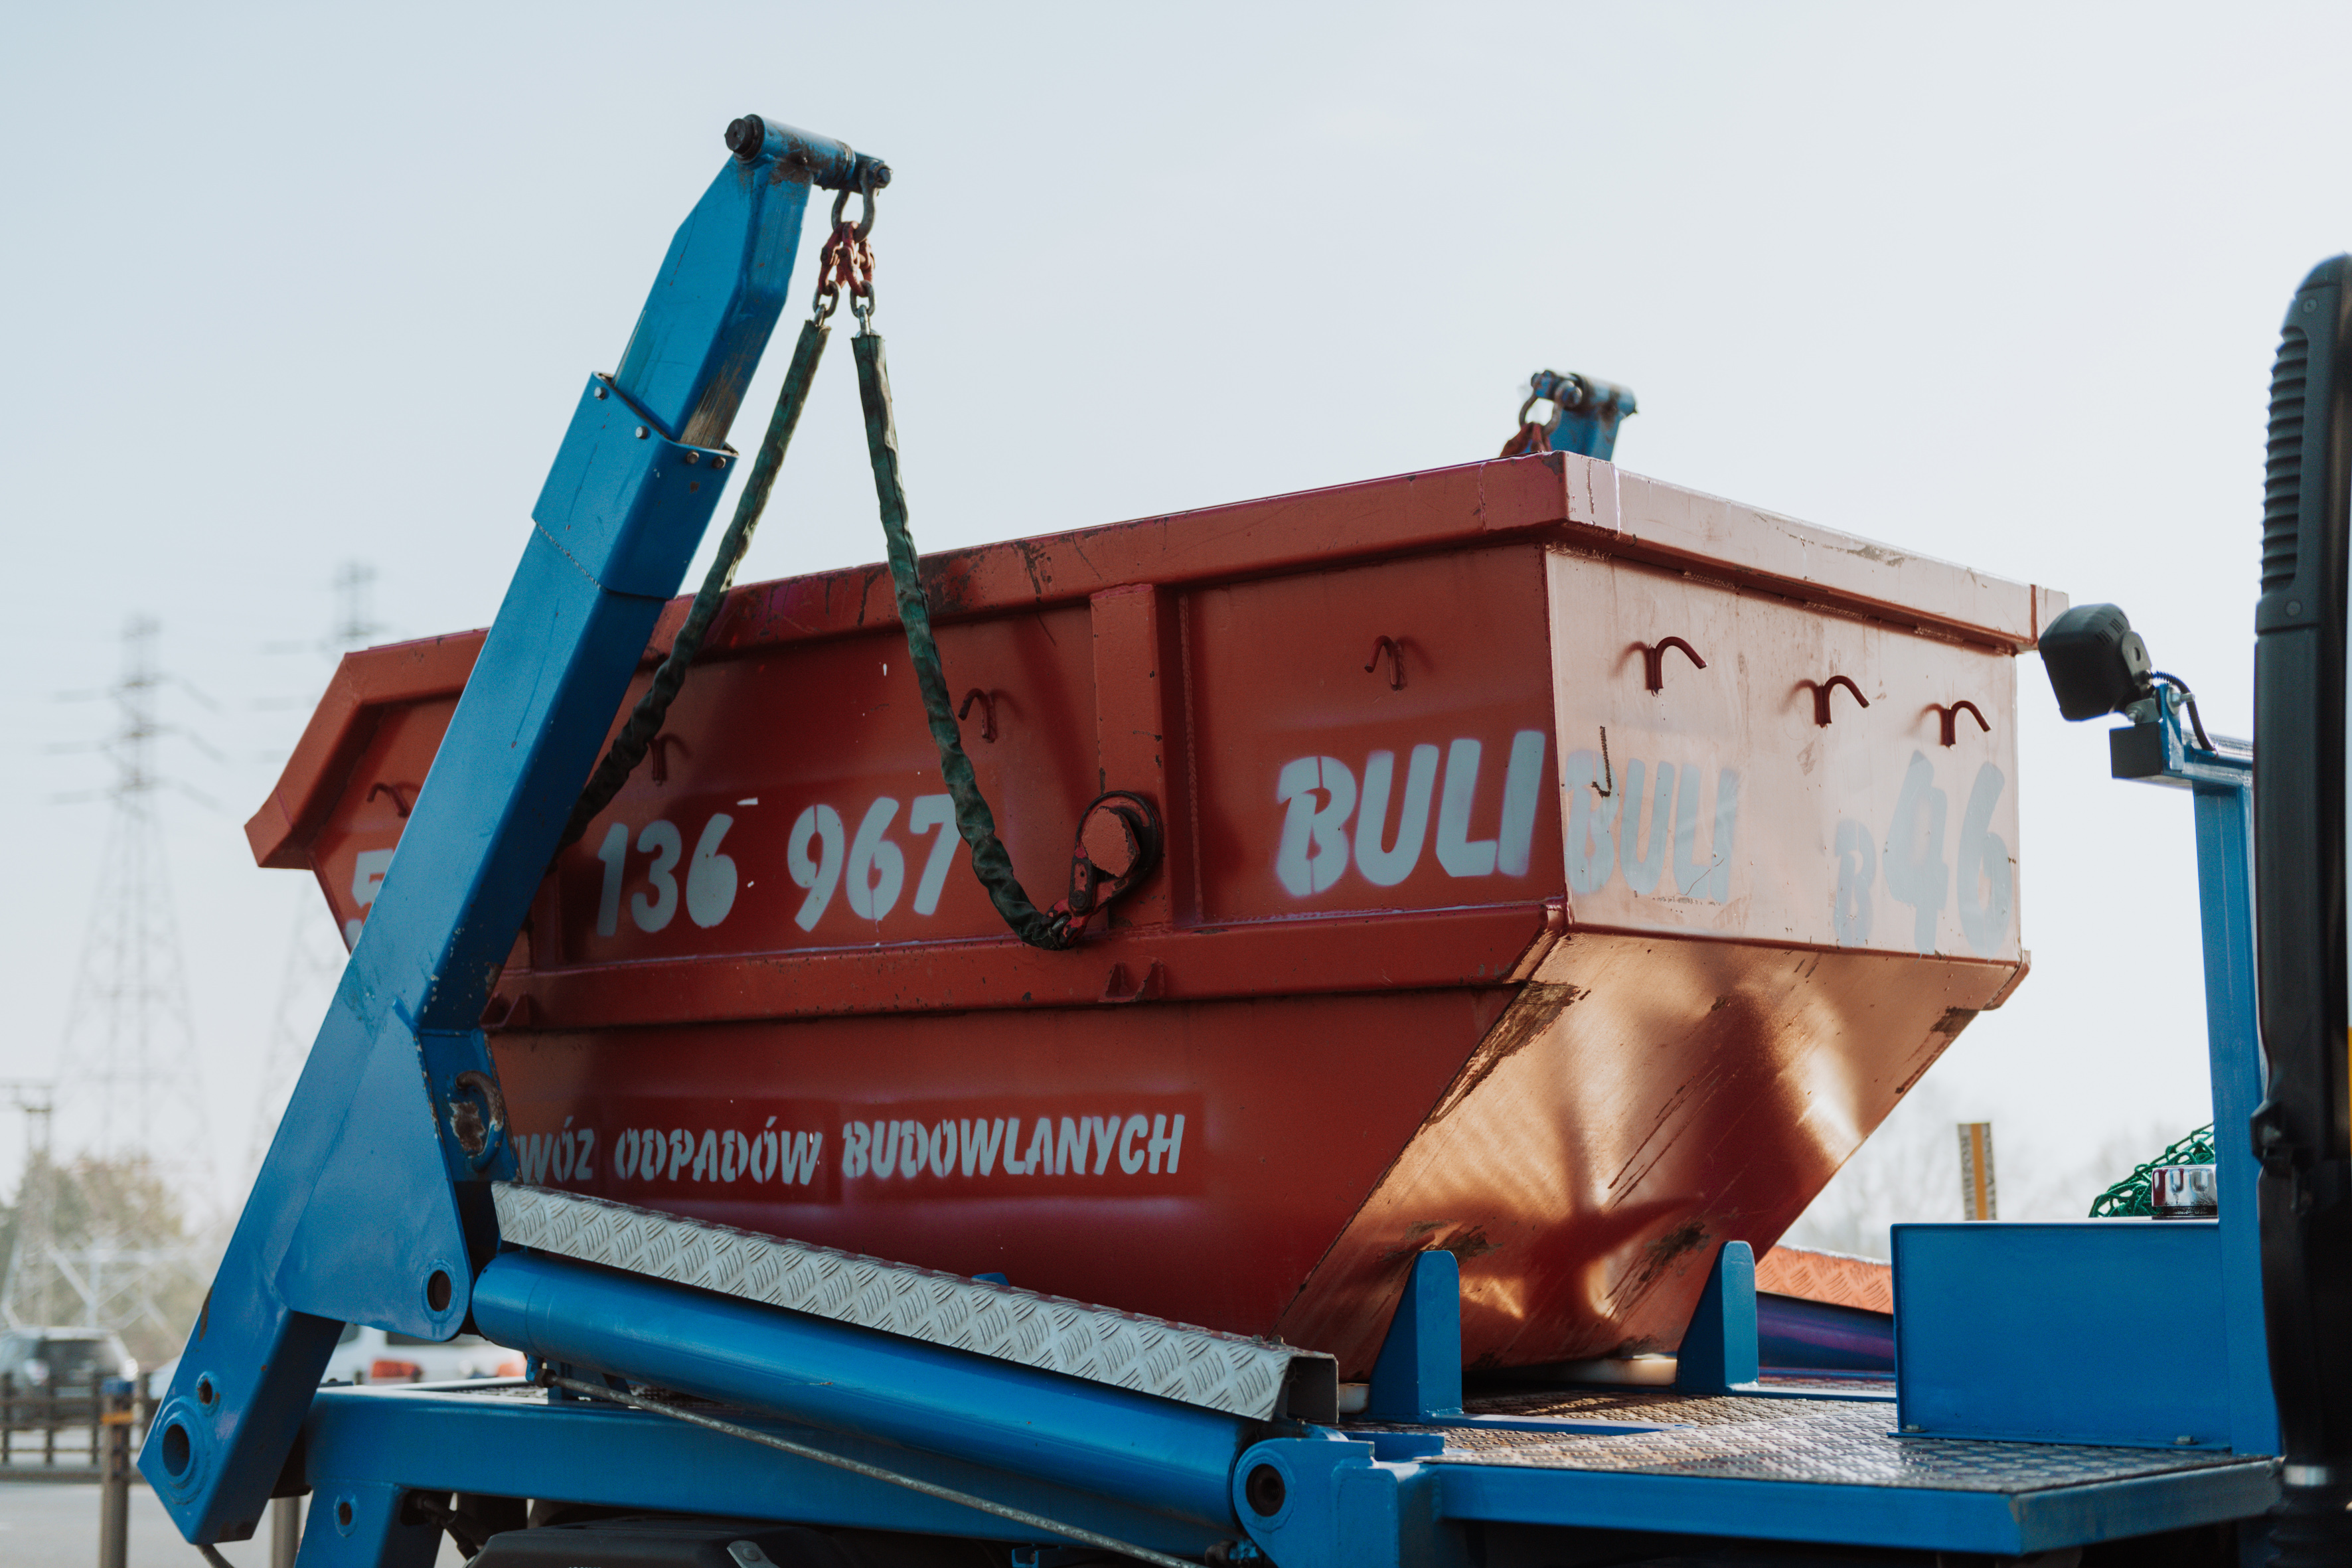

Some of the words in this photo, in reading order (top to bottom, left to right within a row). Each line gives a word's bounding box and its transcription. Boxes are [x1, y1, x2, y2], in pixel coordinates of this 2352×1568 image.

[595, 813, 738, 936] 136
[787, 794, 962, 931] 967
[1276, 729, 1545, 898] BULI
[1565, 749, 1739, 904] BULI
[614, 1116, 823, 1186] ODPADÓW
[842, 1114, 1185, 1178] BUDOWLANYCH
